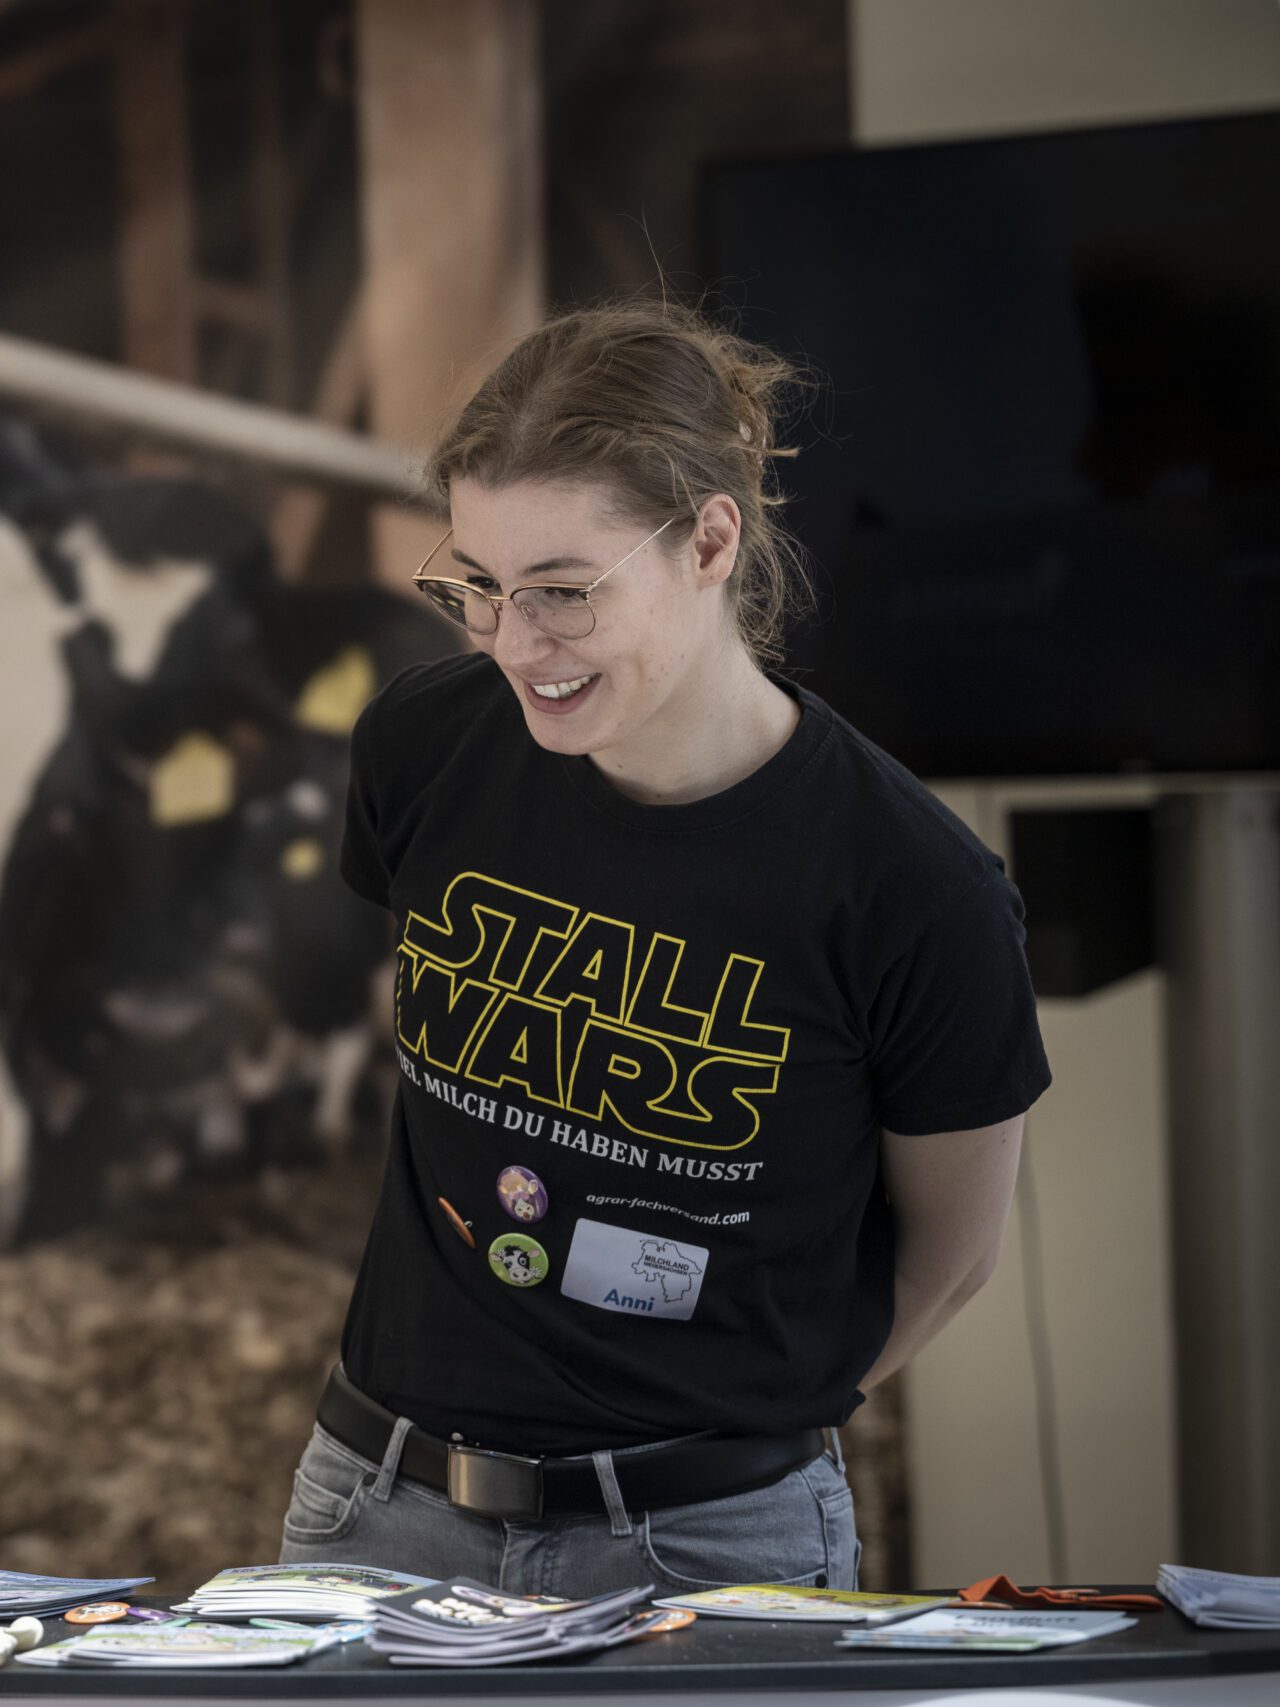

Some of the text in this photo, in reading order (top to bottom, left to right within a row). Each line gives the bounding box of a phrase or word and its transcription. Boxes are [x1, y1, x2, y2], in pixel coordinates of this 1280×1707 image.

[404, 871, 791, 1062] STALL
[396, 943, 782, 1151] WARS
[423, 1071, 497, 1124] MILCH
[503, 1105, 545, 1137] DU
[549, 1120, 649, 1169] HABEN
[656, 1153, 763, 1182] MUSST
[586, 1192, 750, 1225] agrar-fachversand.com
[644, 1254, 690, 1271] MILCHLAND
[603, 1288, 655, 1311] Anni
